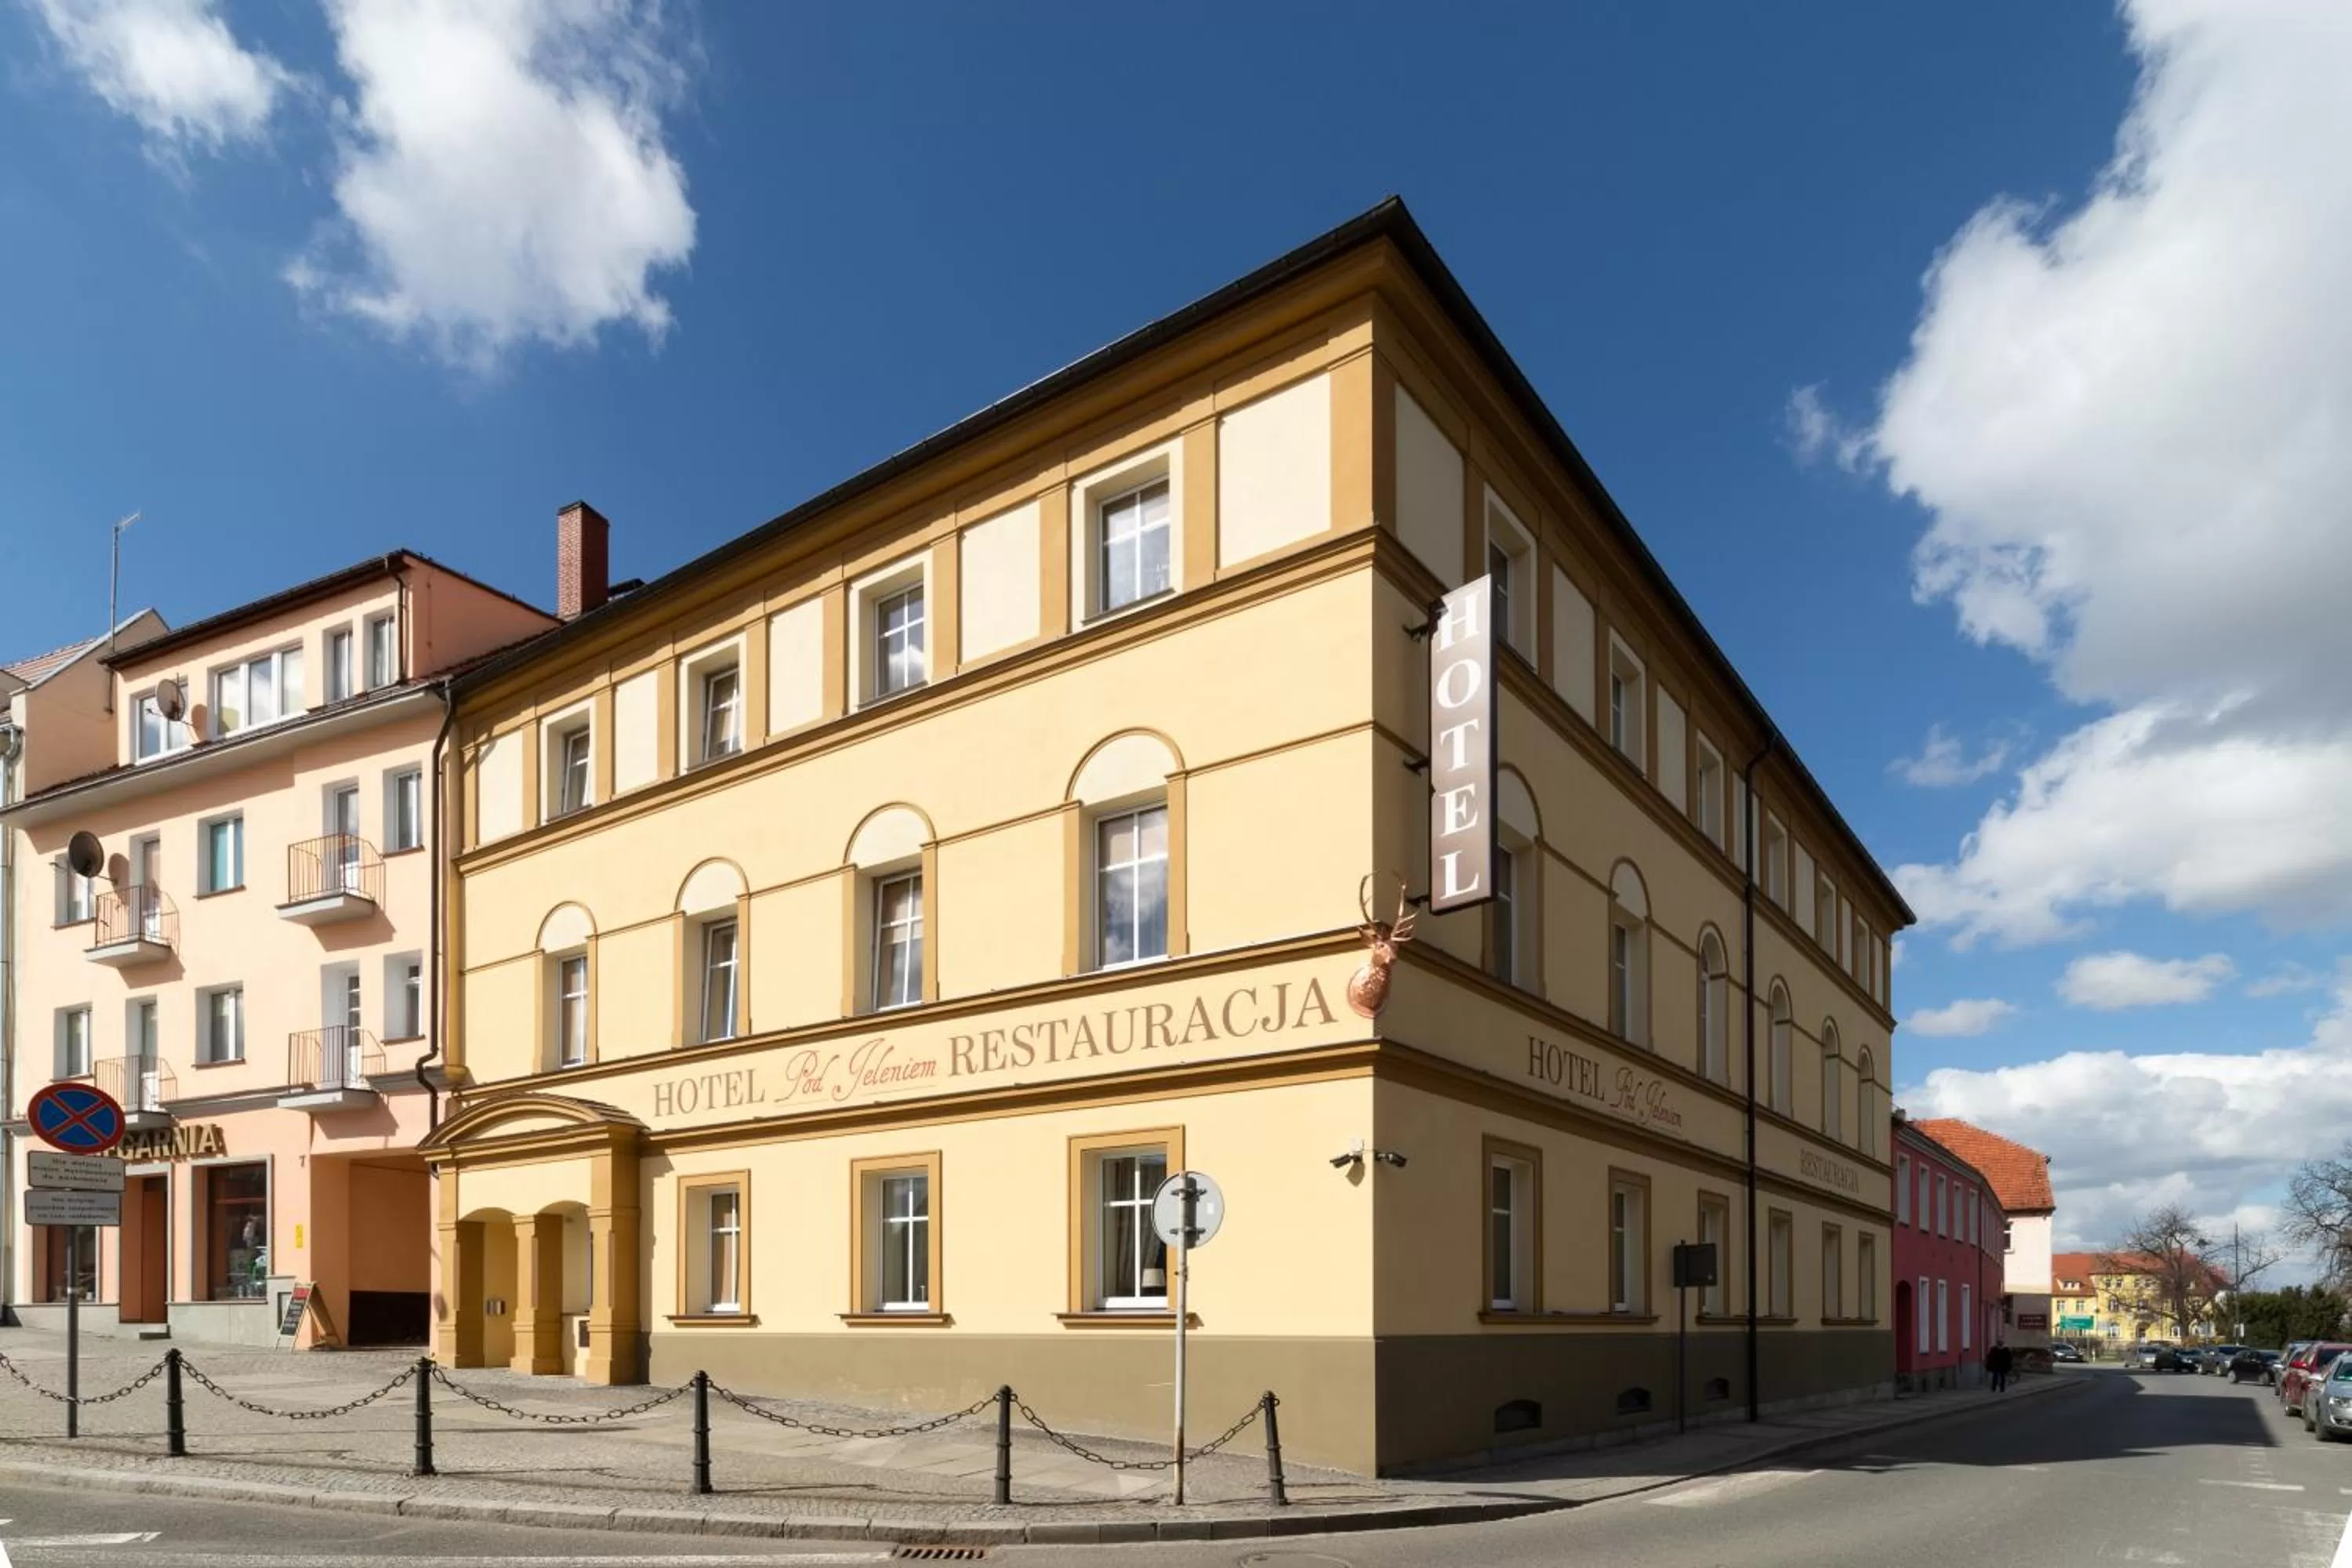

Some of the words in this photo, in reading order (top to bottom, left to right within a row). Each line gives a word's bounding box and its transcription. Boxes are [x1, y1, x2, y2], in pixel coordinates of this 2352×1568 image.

[1436, 590, 1482, 902] HOTEL
[654, 1069, 765, 1117] HOTEL
[774, 1050, 840, 1102] Pod
[831, 1037, 937, 1102] Jeleniem
[947, 977, 1338, 1077] RESTAURACJA
[1527, 1035, 1605, 1102] HOTEL
